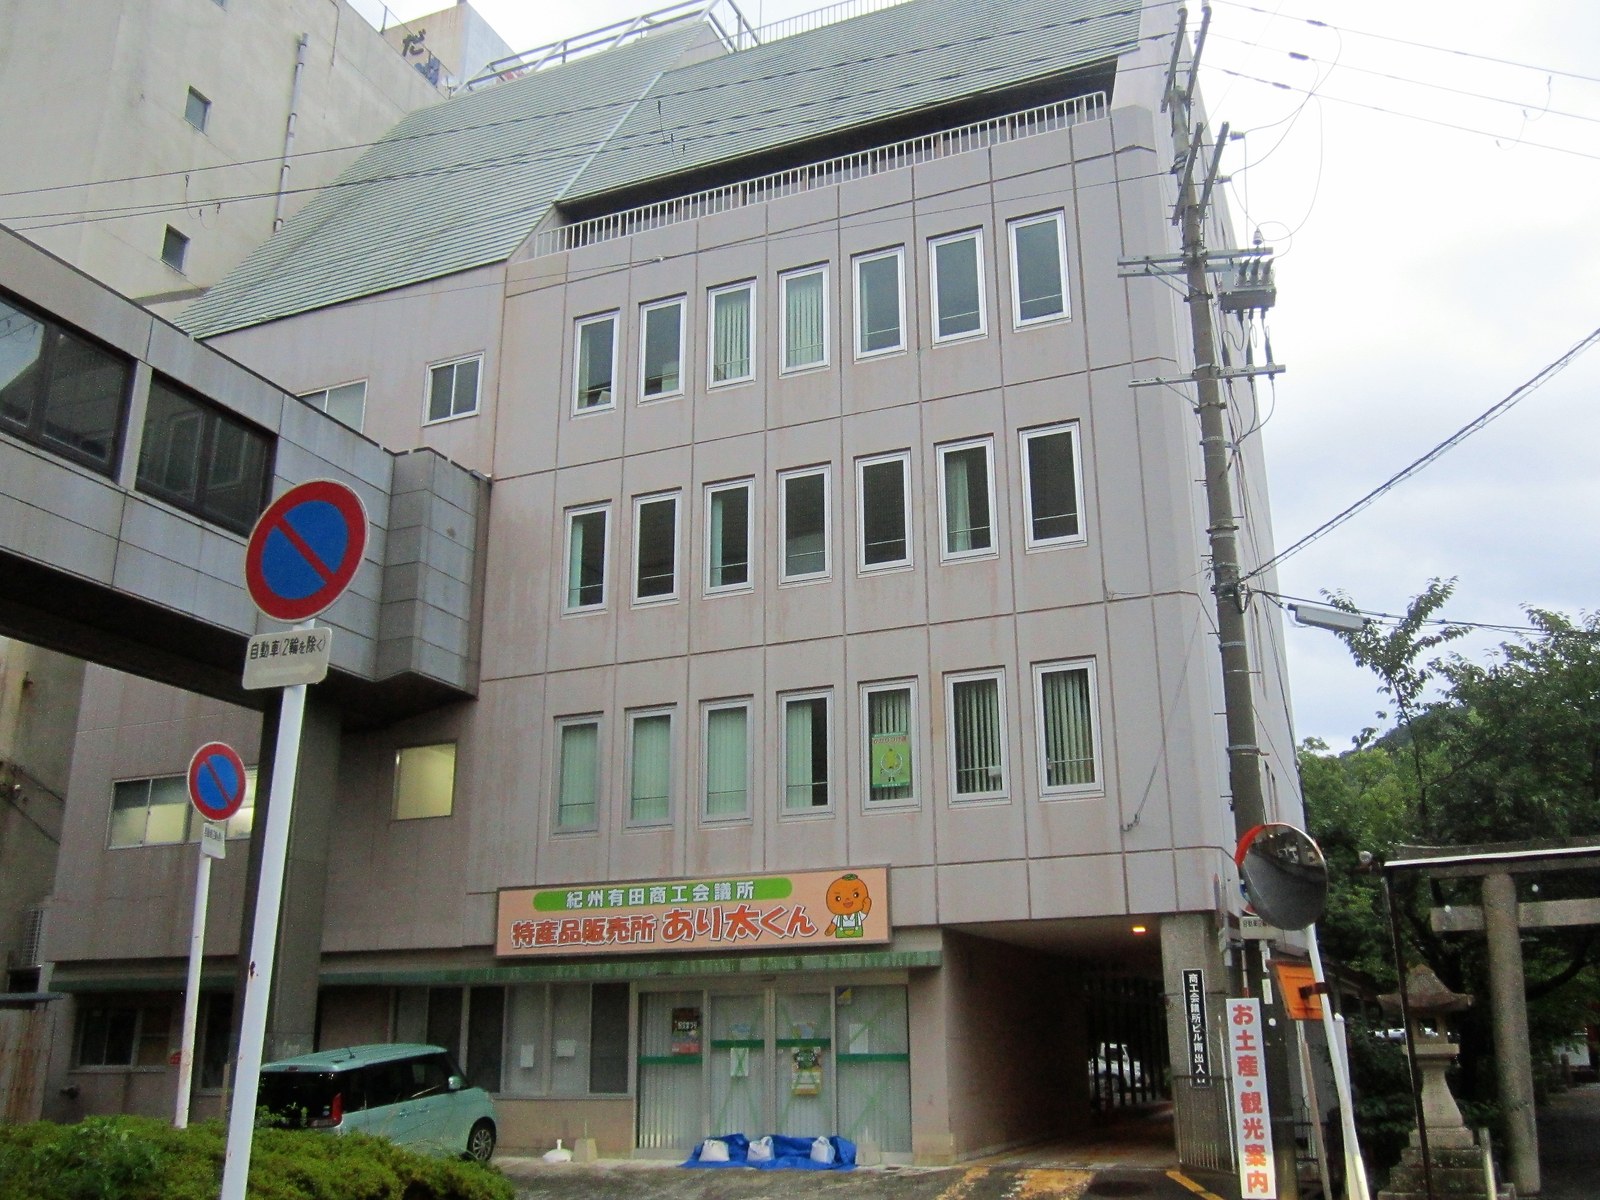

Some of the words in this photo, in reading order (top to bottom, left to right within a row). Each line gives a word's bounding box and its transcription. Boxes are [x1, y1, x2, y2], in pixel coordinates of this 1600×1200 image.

[566, 881, 754, 908] 紀州有田商工会議所
[511, 913, 658, 949] 特産品販売所
[660, 903, 818, 943] あり太くん
[1232, 1004, 1269, 1194] お土産・観光案内
